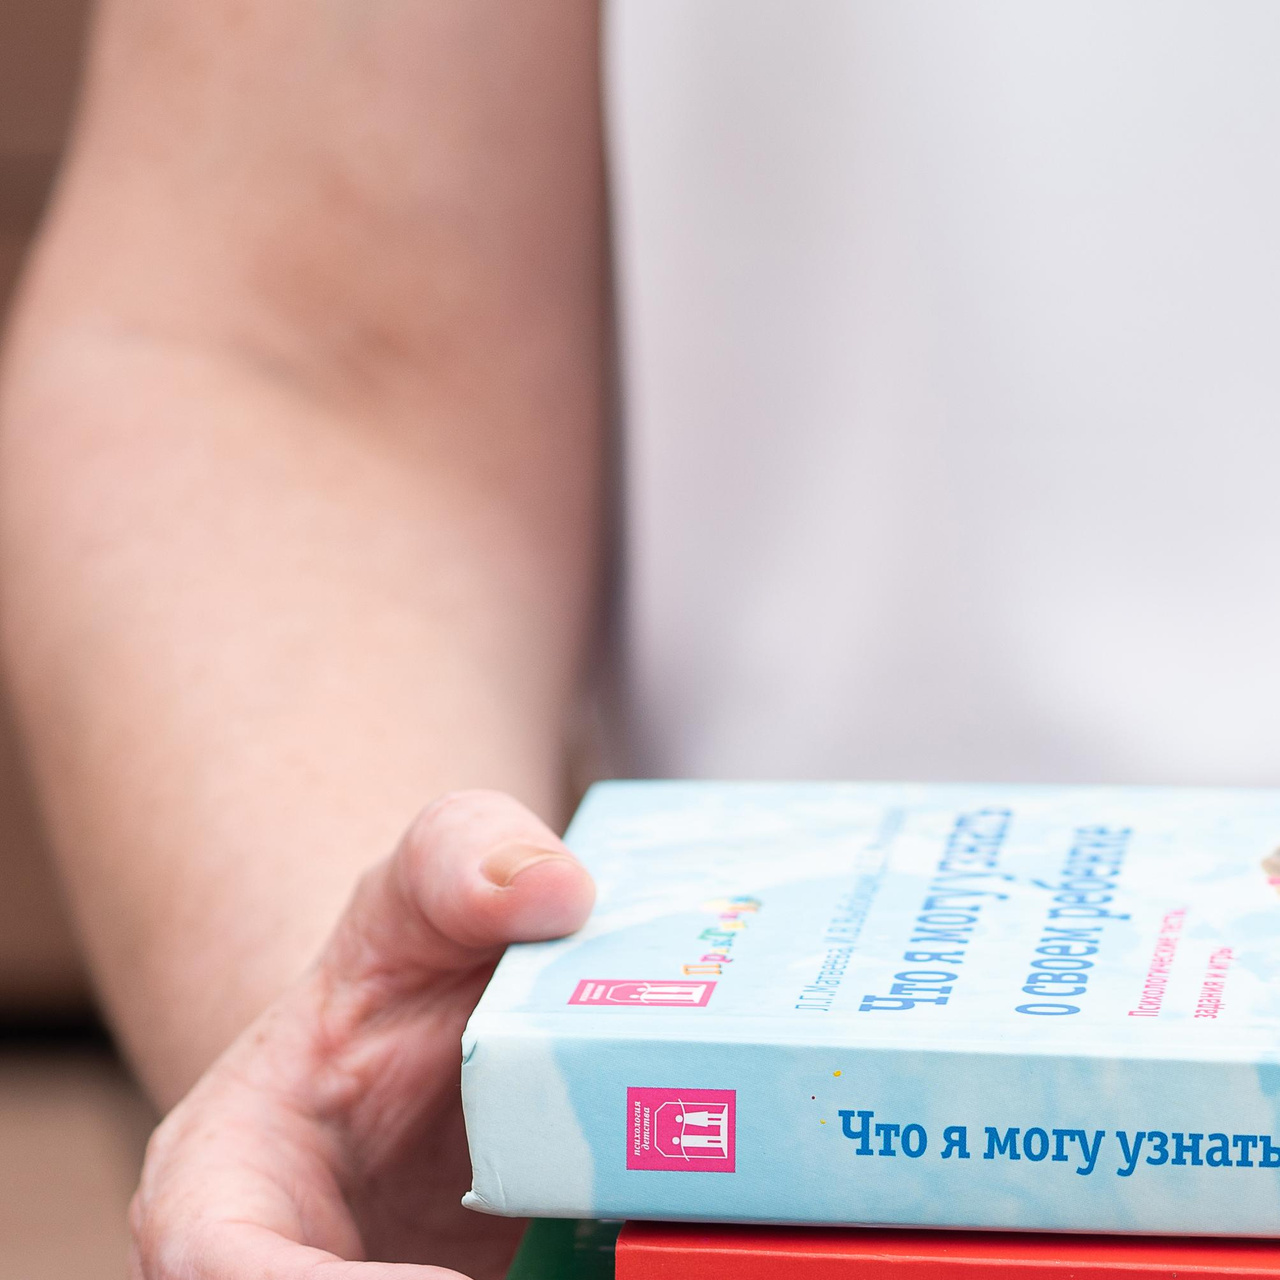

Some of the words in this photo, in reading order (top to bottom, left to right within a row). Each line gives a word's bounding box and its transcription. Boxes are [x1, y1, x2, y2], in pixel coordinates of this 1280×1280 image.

[1031, 826, 1132, 921] ребенке
[910, 885, 1010, 944] могу
[903, 951, 965, 963] я
[1022, 926, 1103, 997] своем
[1128, 938, 1178, 1017] Психологические
[858, 970, 958, 1012] Что
[1015, 1003, 1081, 1016] о
[1194, 982, 1226, 1019] задания
[641, 1106, 650, 1151] детства
[837, 1109, 928, 1159] Что
[940, 1125, 971, 1160] я
[982, 1126, 1106, 1176] могу
